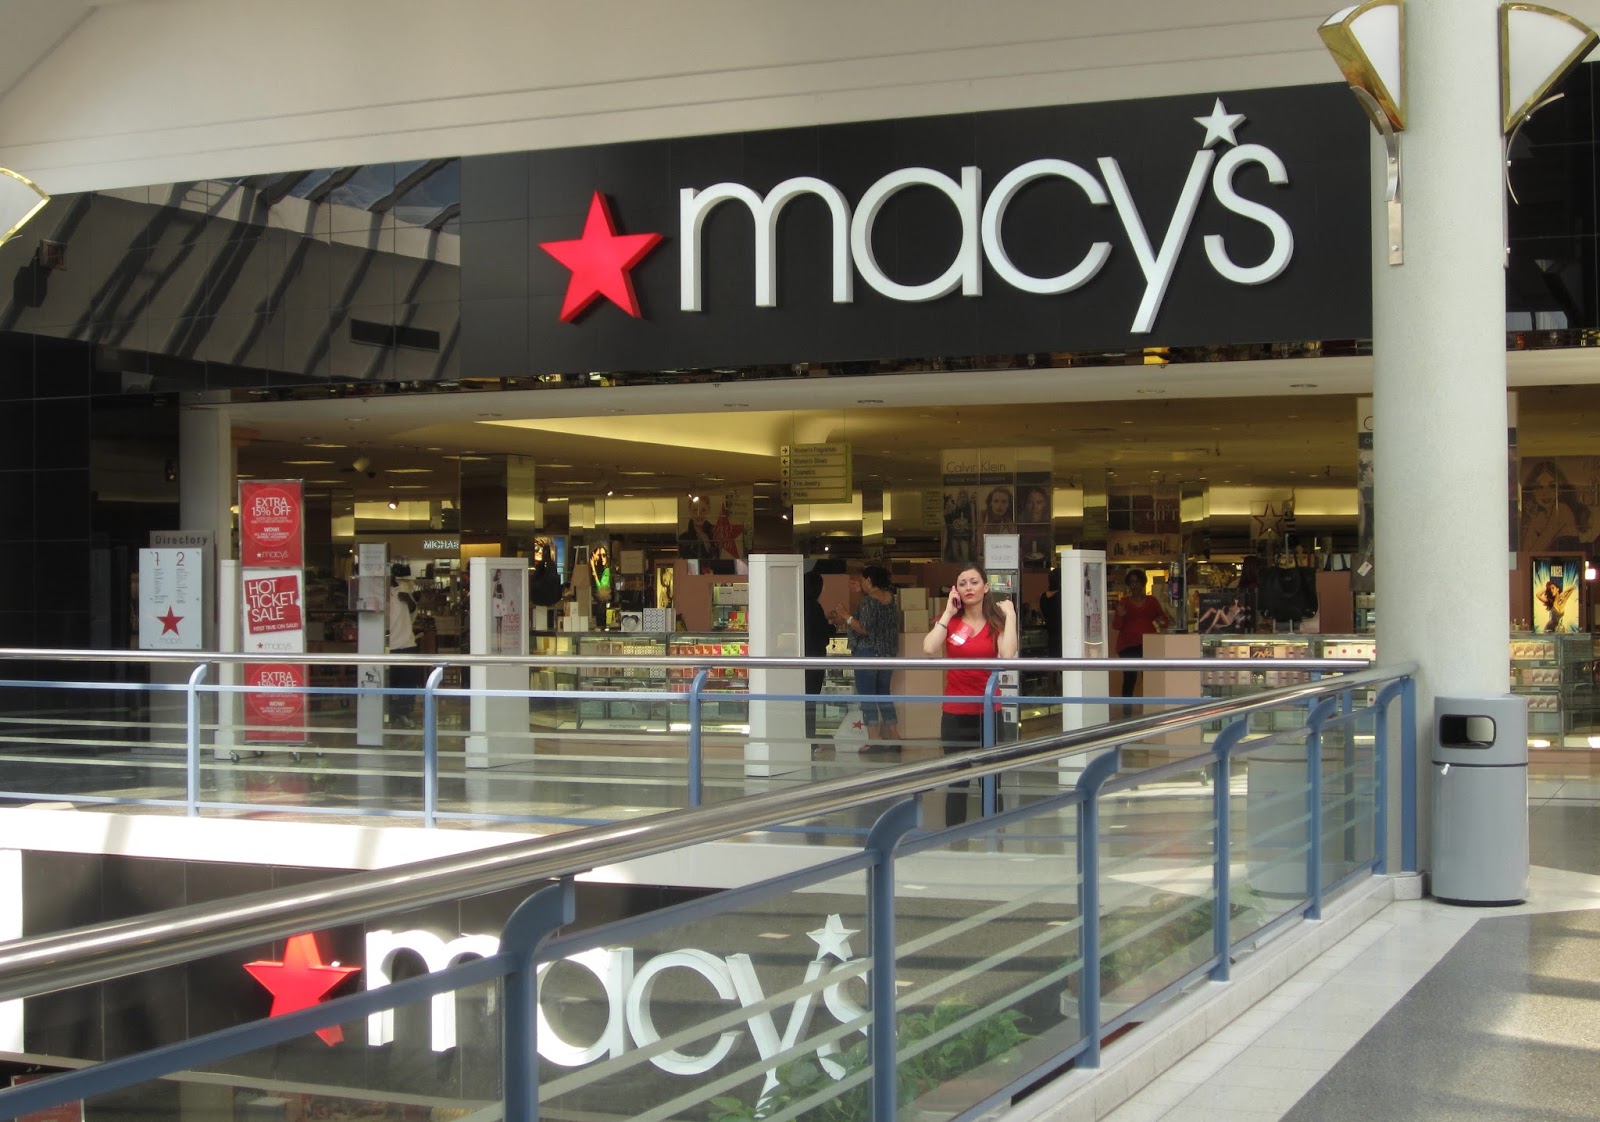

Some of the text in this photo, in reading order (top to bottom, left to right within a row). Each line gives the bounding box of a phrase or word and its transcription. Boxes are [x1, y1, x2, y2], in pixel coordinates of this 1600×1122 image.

[981, 461, 1006, 472] Klein
[255, 497, 288, 507] EXTRA
[251, 506, 292, 516] 15% OFF
[155, 535, 208, 546] Directory
[176, 551, 185, 566] 2
[248, 579, 277, 595] HOT
[249, 591, 295, 608] TICKET
[251, 606, 284, 622] SALE
[261, 671, 293, 681] EXTRA
